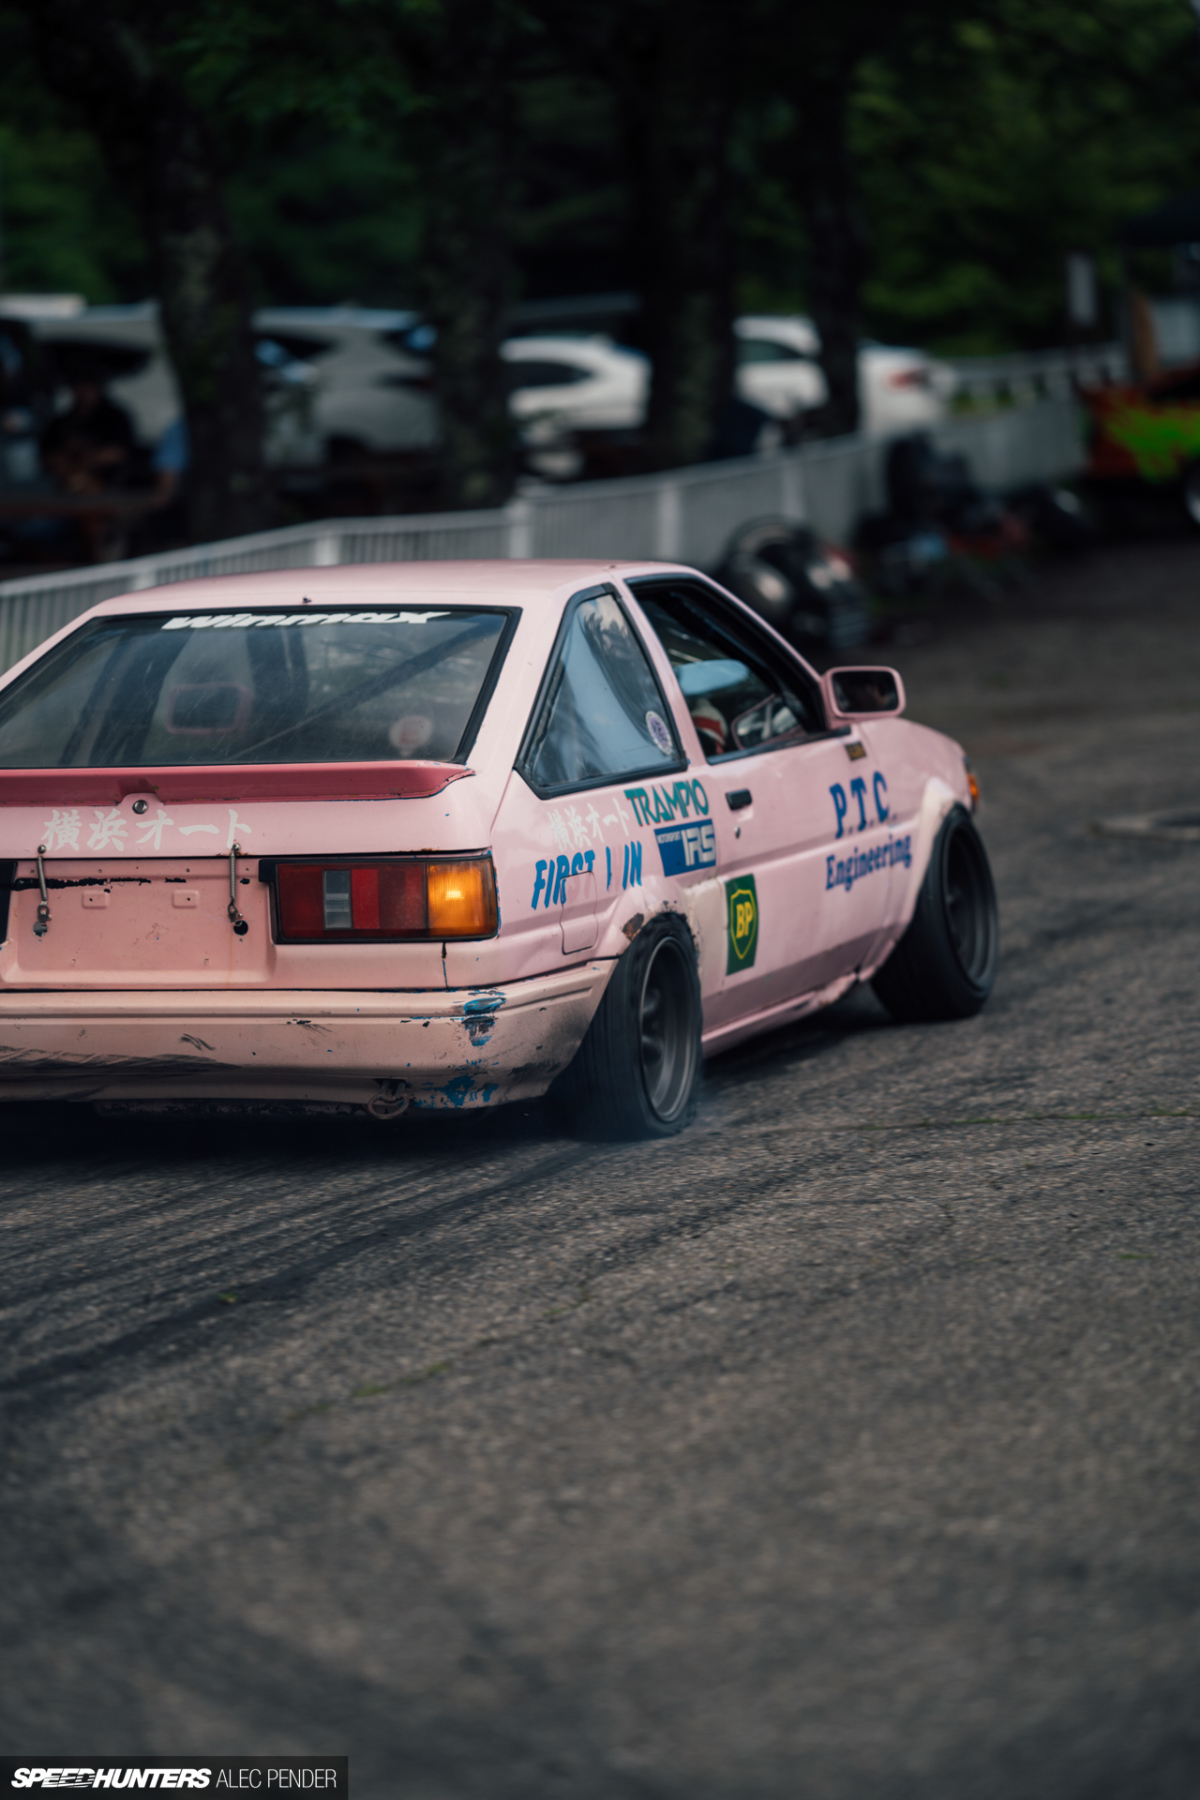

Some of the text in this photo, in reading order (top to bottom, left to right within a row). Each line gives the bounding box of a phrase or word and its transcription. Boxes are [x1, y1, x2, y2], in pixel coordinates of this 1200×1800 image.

[547, 797, 630, 853] 横浜オート
[623, 778, 709, 827] TRAMPIO
[829, 770, 897, 840] P.T.C.
[41, 808, 252, 852] 横浜オート
[826, 834, 912, 892] Engineering
[736, 901, 753, 938] BP
